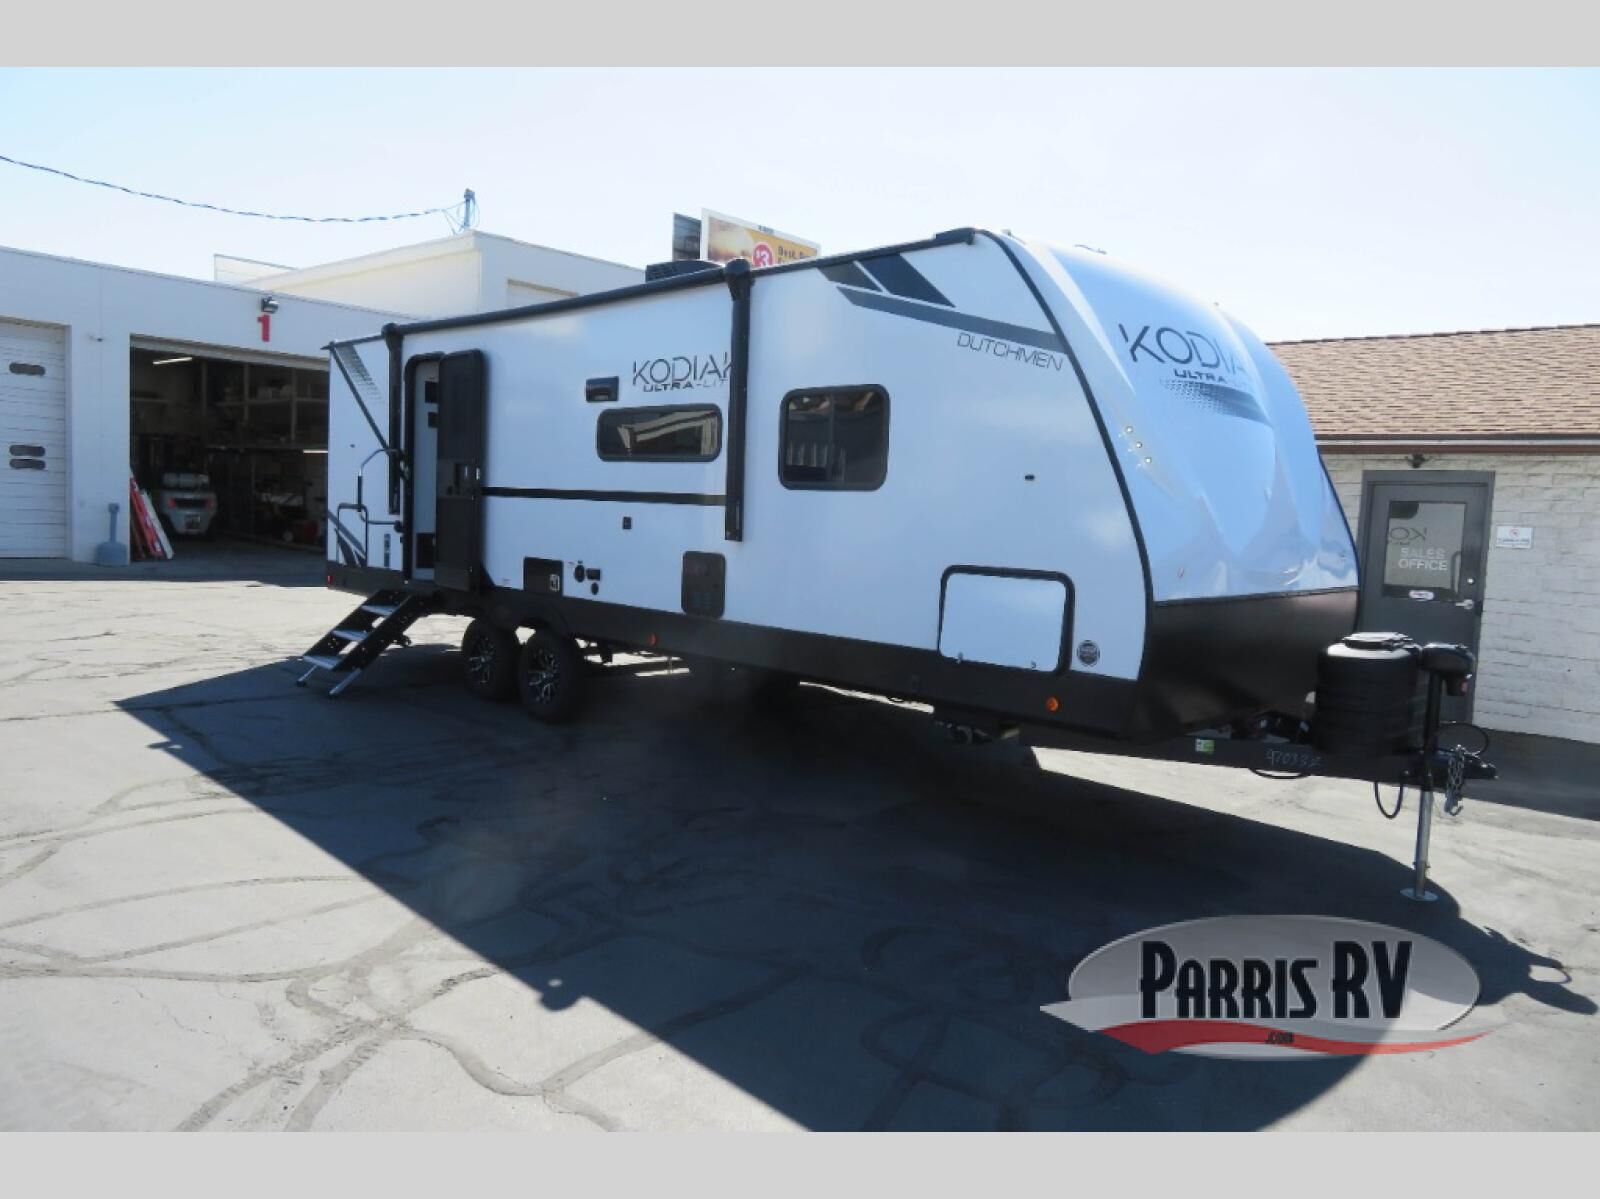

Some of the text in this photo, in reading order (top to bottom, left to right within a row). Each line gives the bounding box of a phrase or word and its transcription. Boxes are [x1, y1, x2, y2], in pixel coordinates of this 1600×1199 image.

[257, 314, 271, 342] 1
[956, 332, 1064, 372] DUTCHMEN
[1400, 547, 1446, 560] SALES
[1398, 558, 1448, 571] OFFICE
